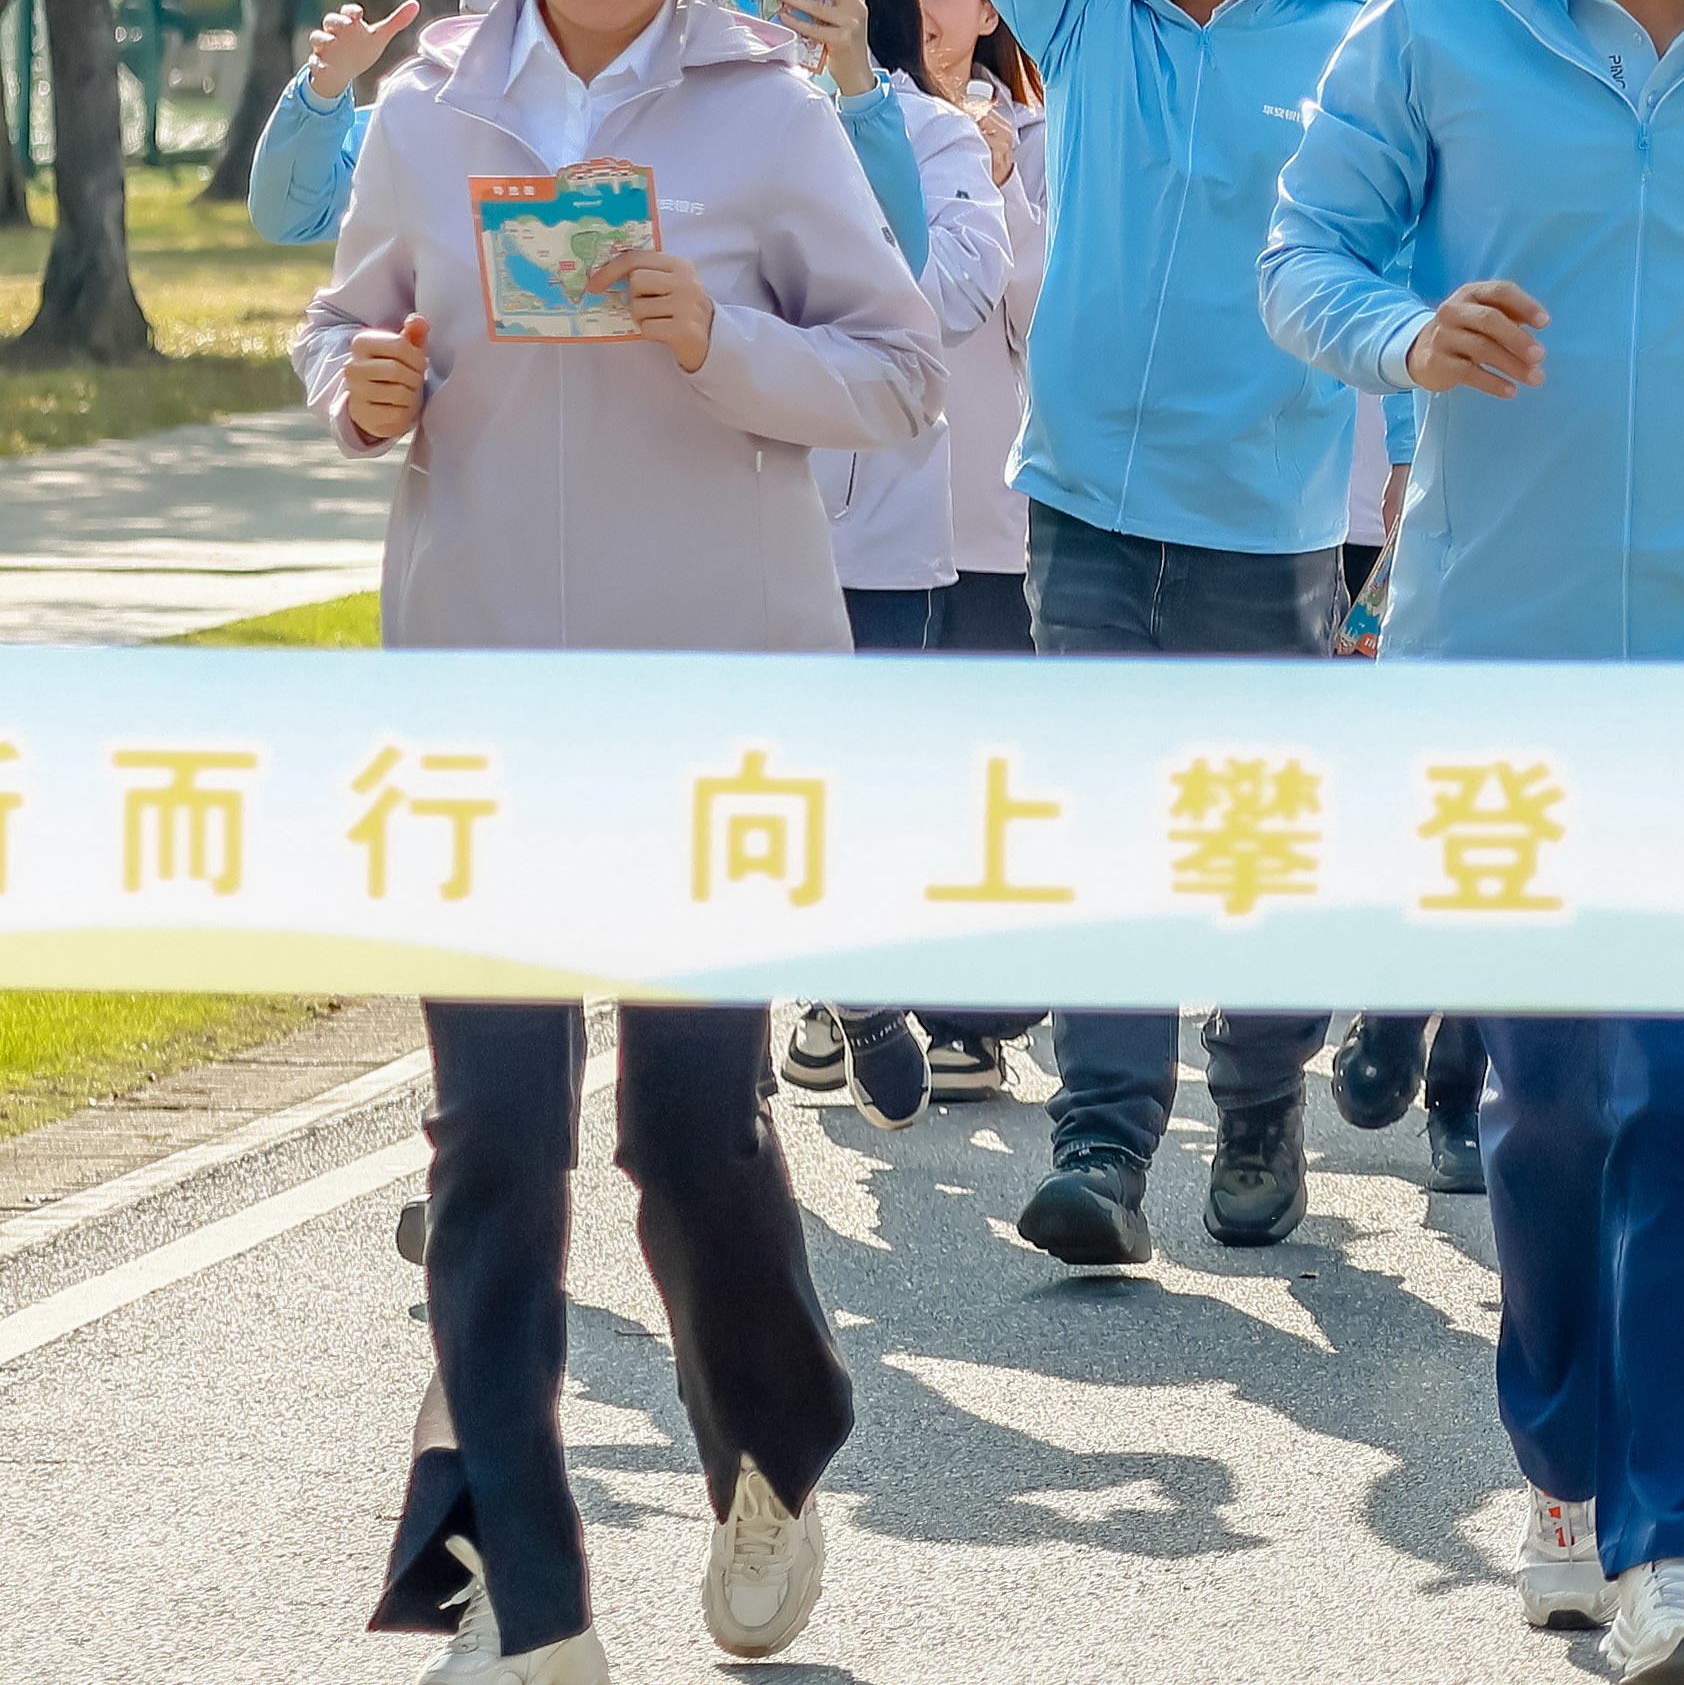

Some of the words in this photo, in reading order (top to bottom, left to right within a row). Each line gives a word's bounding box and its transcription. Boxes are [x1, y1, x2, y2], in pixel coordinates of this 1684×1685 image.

[0, 743, 498, 903] 而行
[691, 746, 1565, 916] 向上攀登
